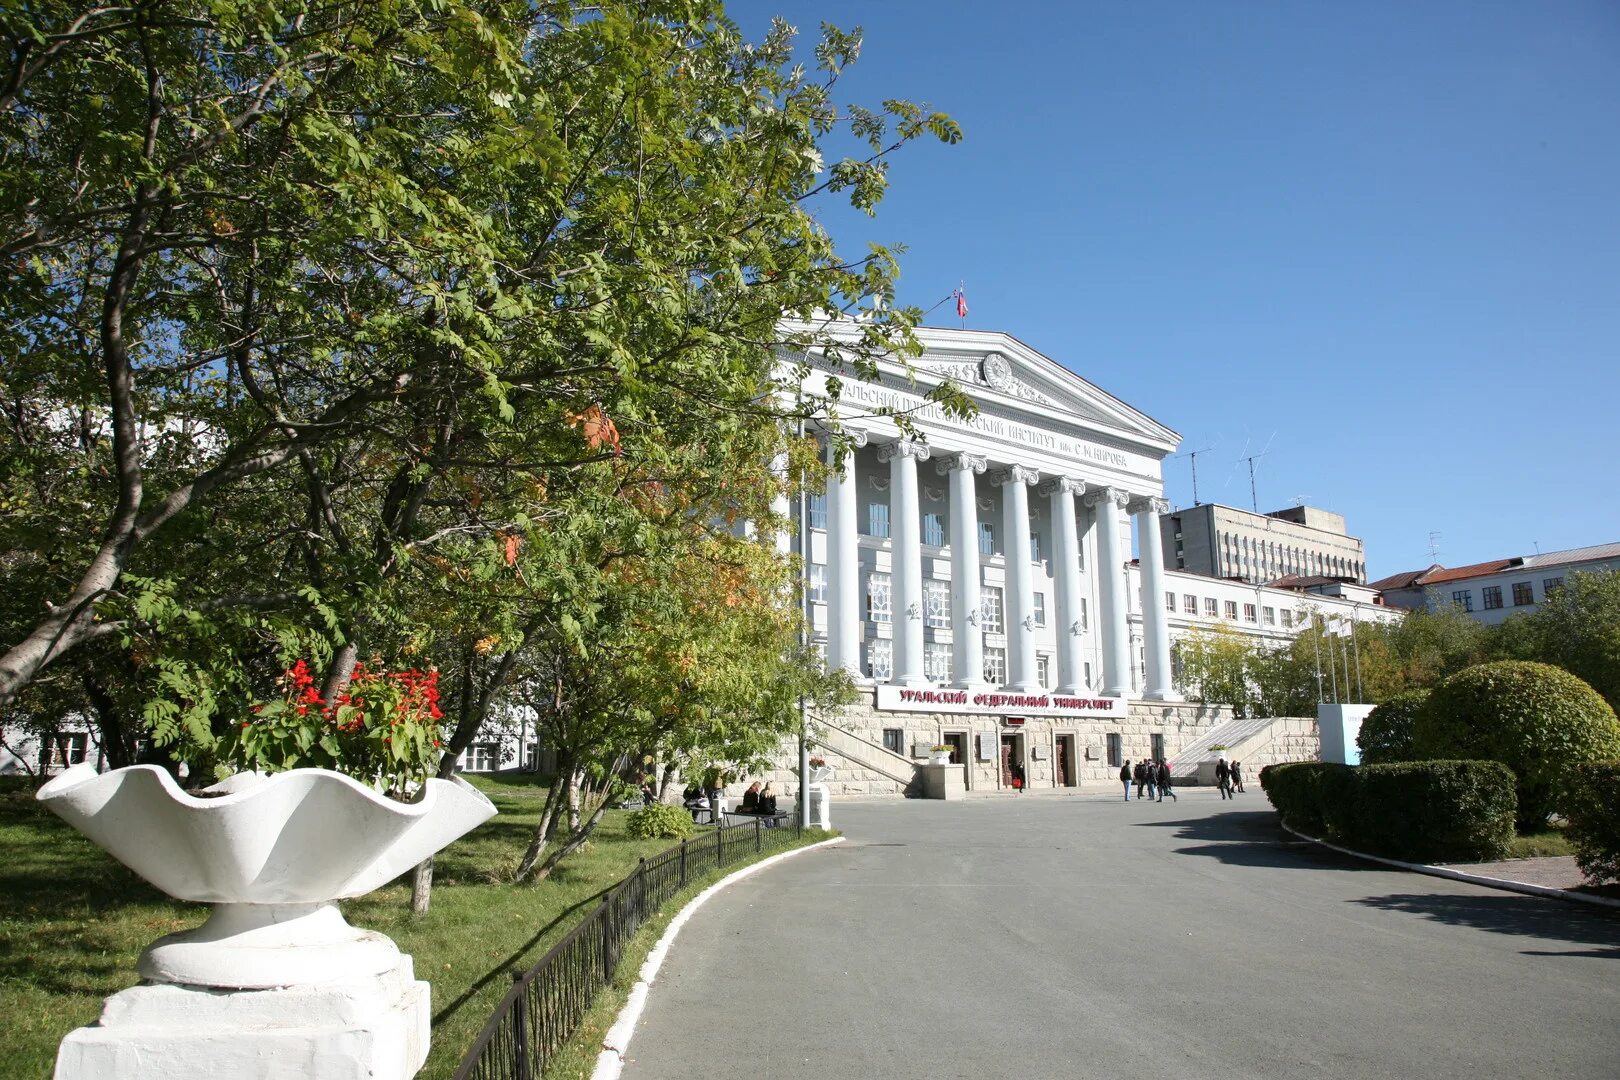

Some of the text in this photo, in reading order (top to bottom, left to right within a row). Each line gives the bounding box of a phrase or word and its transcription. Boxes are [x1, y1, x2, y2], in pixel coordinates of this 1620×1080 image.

[841, 381, 900, 412] АЛЬСКИЙ
[902, 397, 1004, 436] ПОЛИТЕСКИЙ
[1008, 424, 1056, 449] ИНСТИТУТ
[899, 689, 968, 705] УРАЛЬСКИЙ
[973, 693, 1050, 709] ФЕДЕРАЛЬНЫЙ
[1053, 697, 1114, 711] УНИВЕРСИТЕТ
